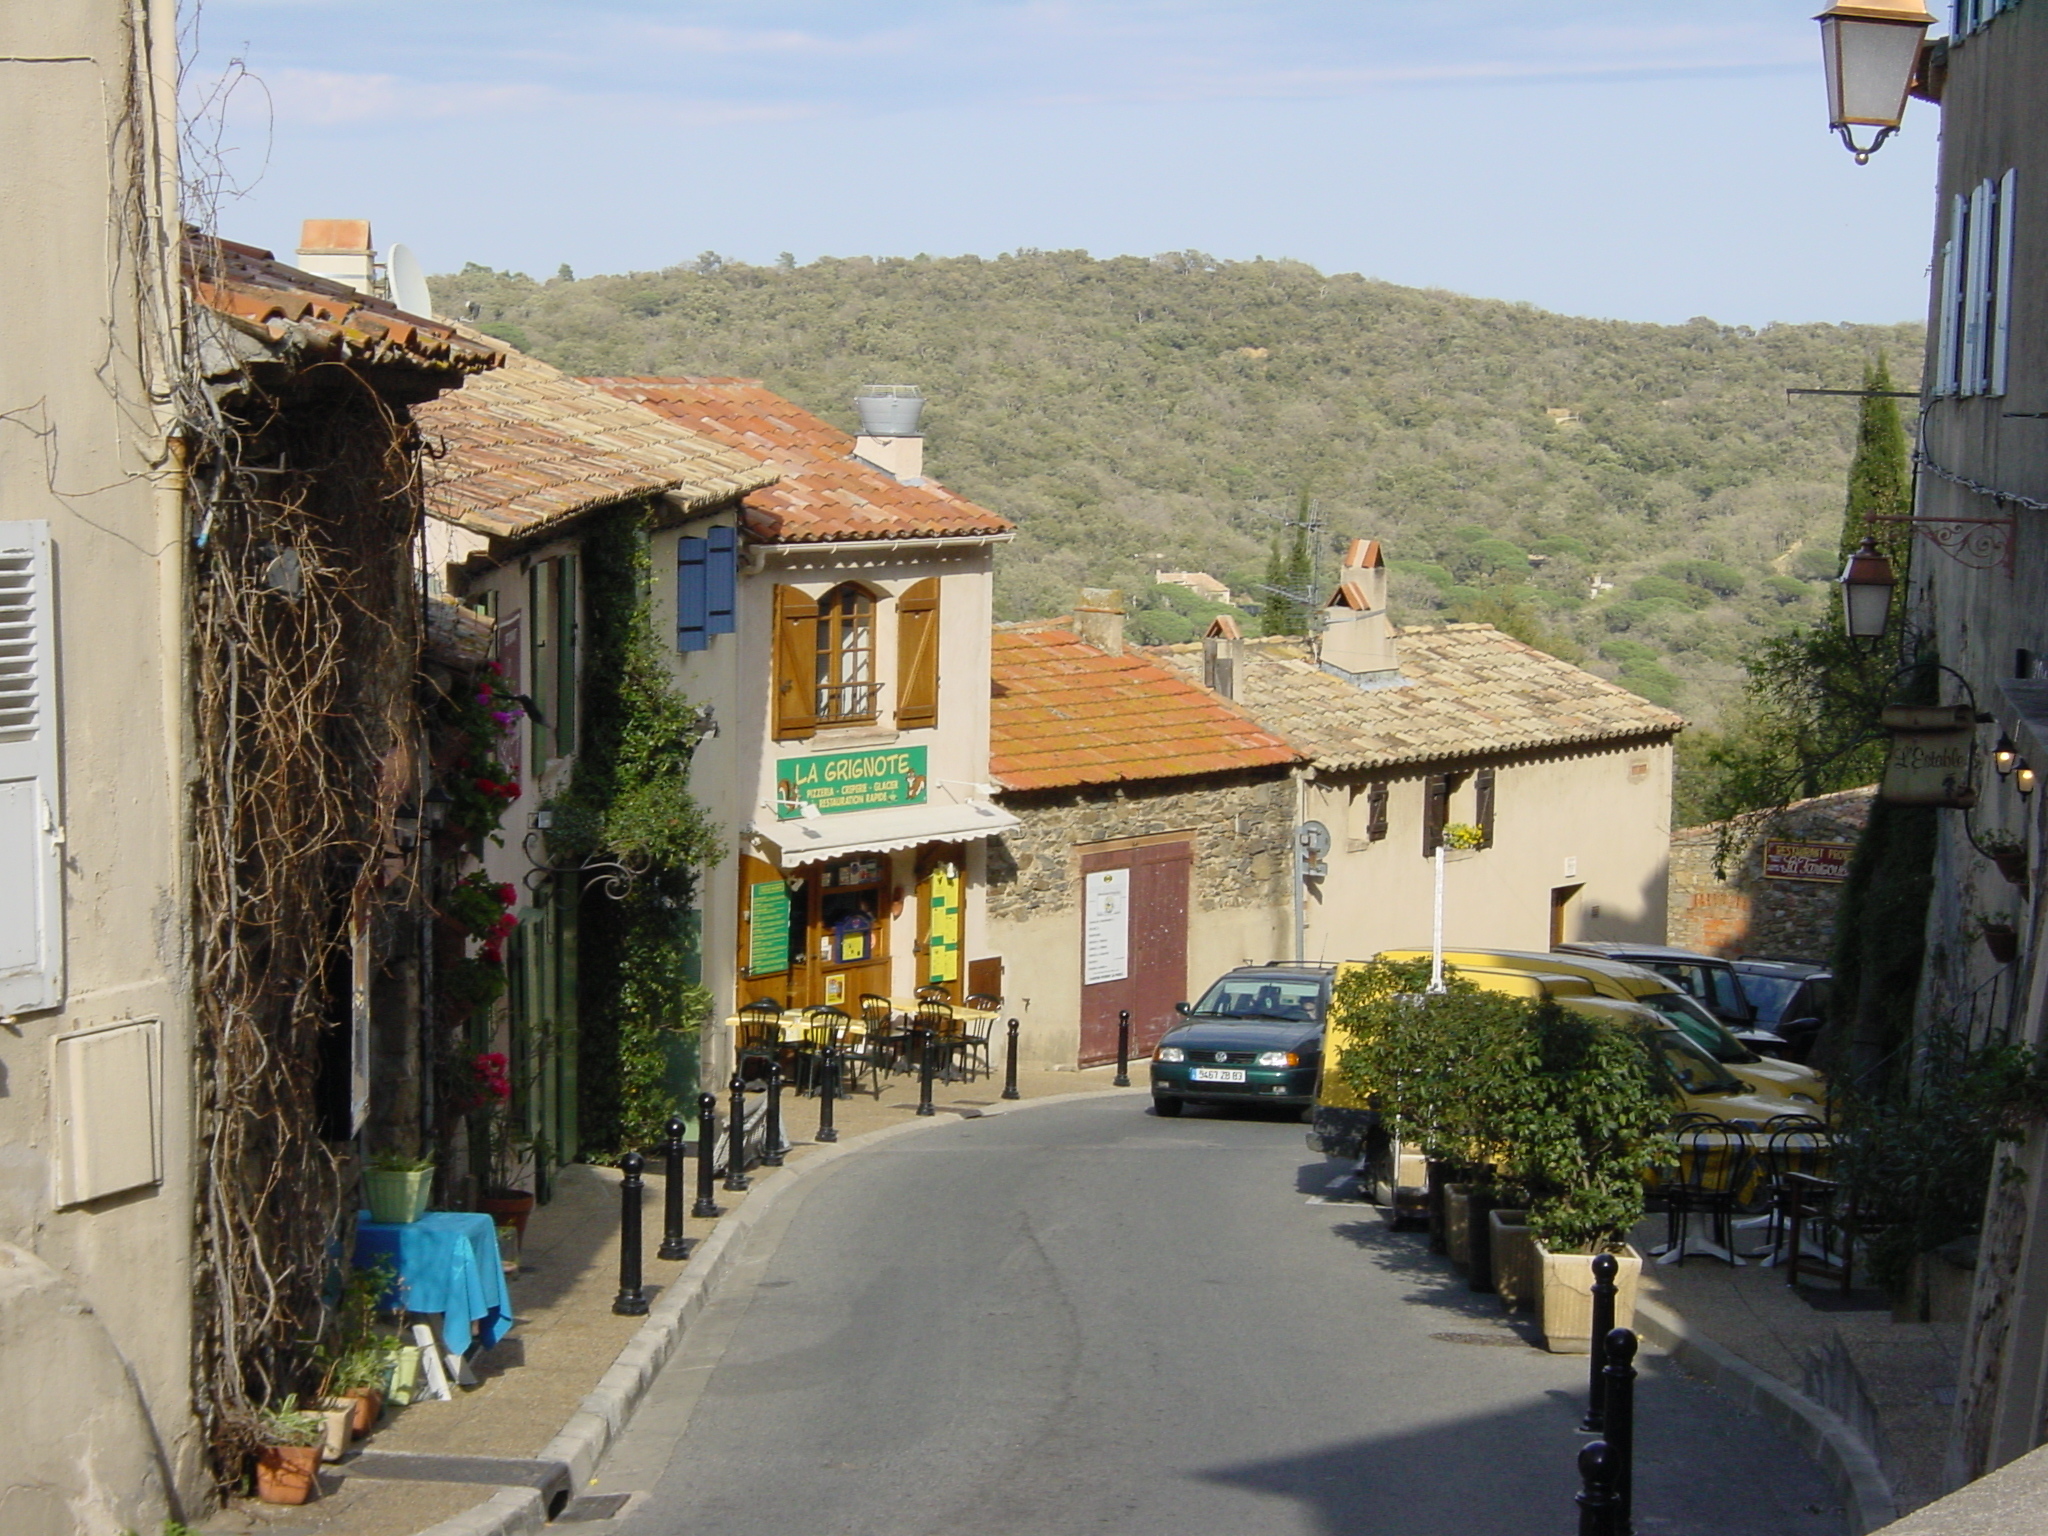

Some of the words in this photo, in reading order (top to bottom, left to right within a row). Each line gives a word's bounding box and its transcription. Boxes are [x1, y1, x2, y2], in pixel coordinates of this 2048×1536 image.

[796, 763, 818, 785] LA
[825, 754, 910, 782] GRIGNOTE
[806, 787, 834, 798] PIZZERIA
[874, 780, 898, 791] GLACIER
[819, 795, 864, 808] RESTAURATION
[866, 792, 887, 802] RAPIDE
